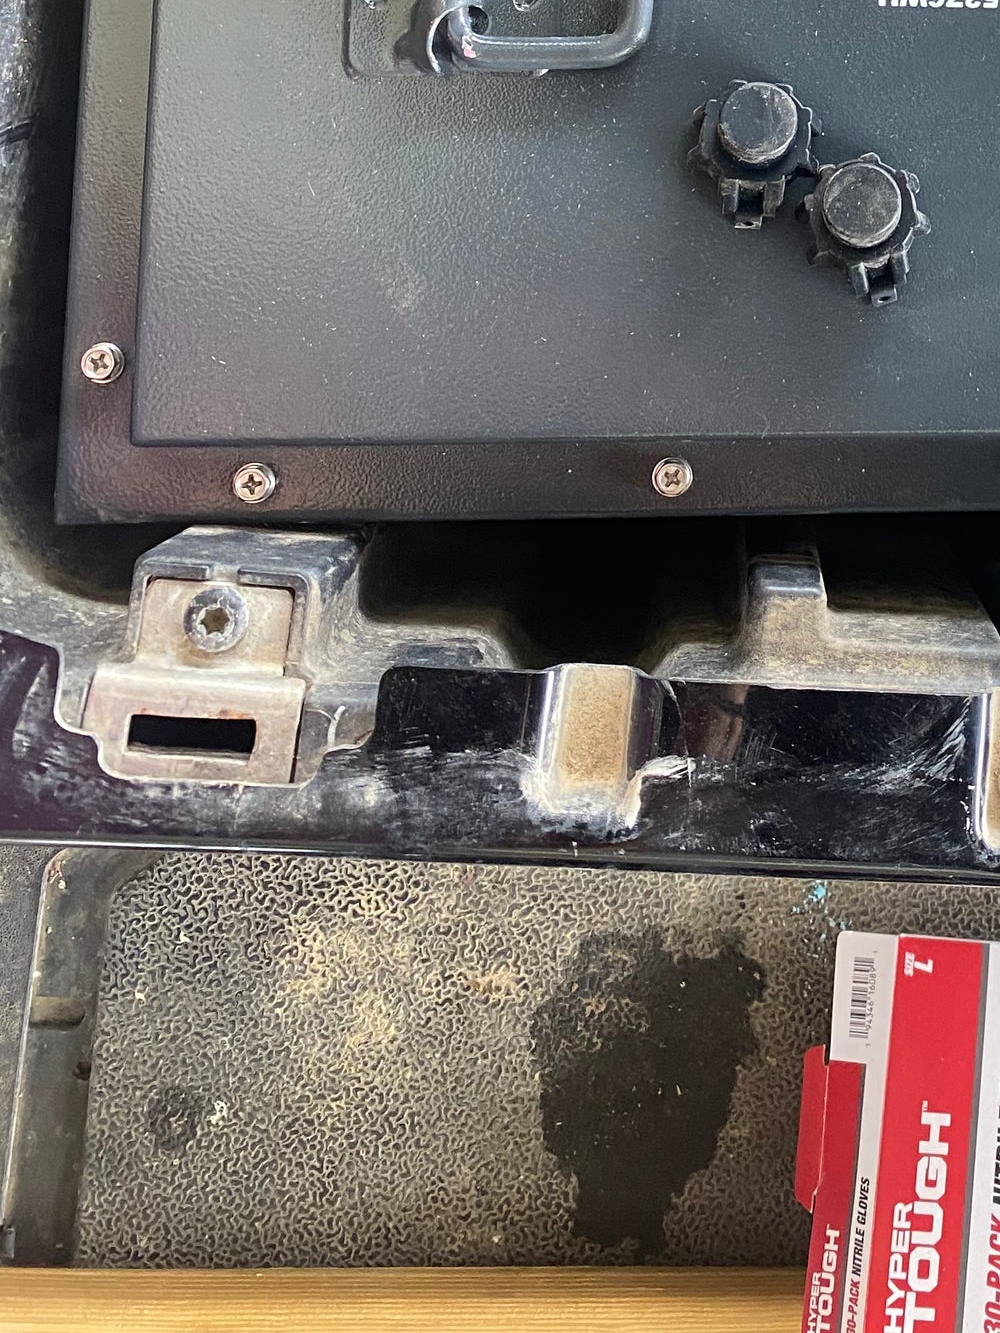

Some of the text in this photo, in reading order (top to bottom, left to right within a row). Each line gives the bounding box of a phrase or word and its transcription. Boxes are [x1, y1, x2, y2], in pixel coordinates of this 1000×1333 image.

[914, 958, 934, 974] L
[866, 966, 876, 1030] 94346 16089
[856, 1176, 869, 1224] GLOVES
[851, 1227, 864, 1276] NITRILE
[883, 1202, 914, 1333] HYPER
[806, 1272, 822, 1333] HYPER
